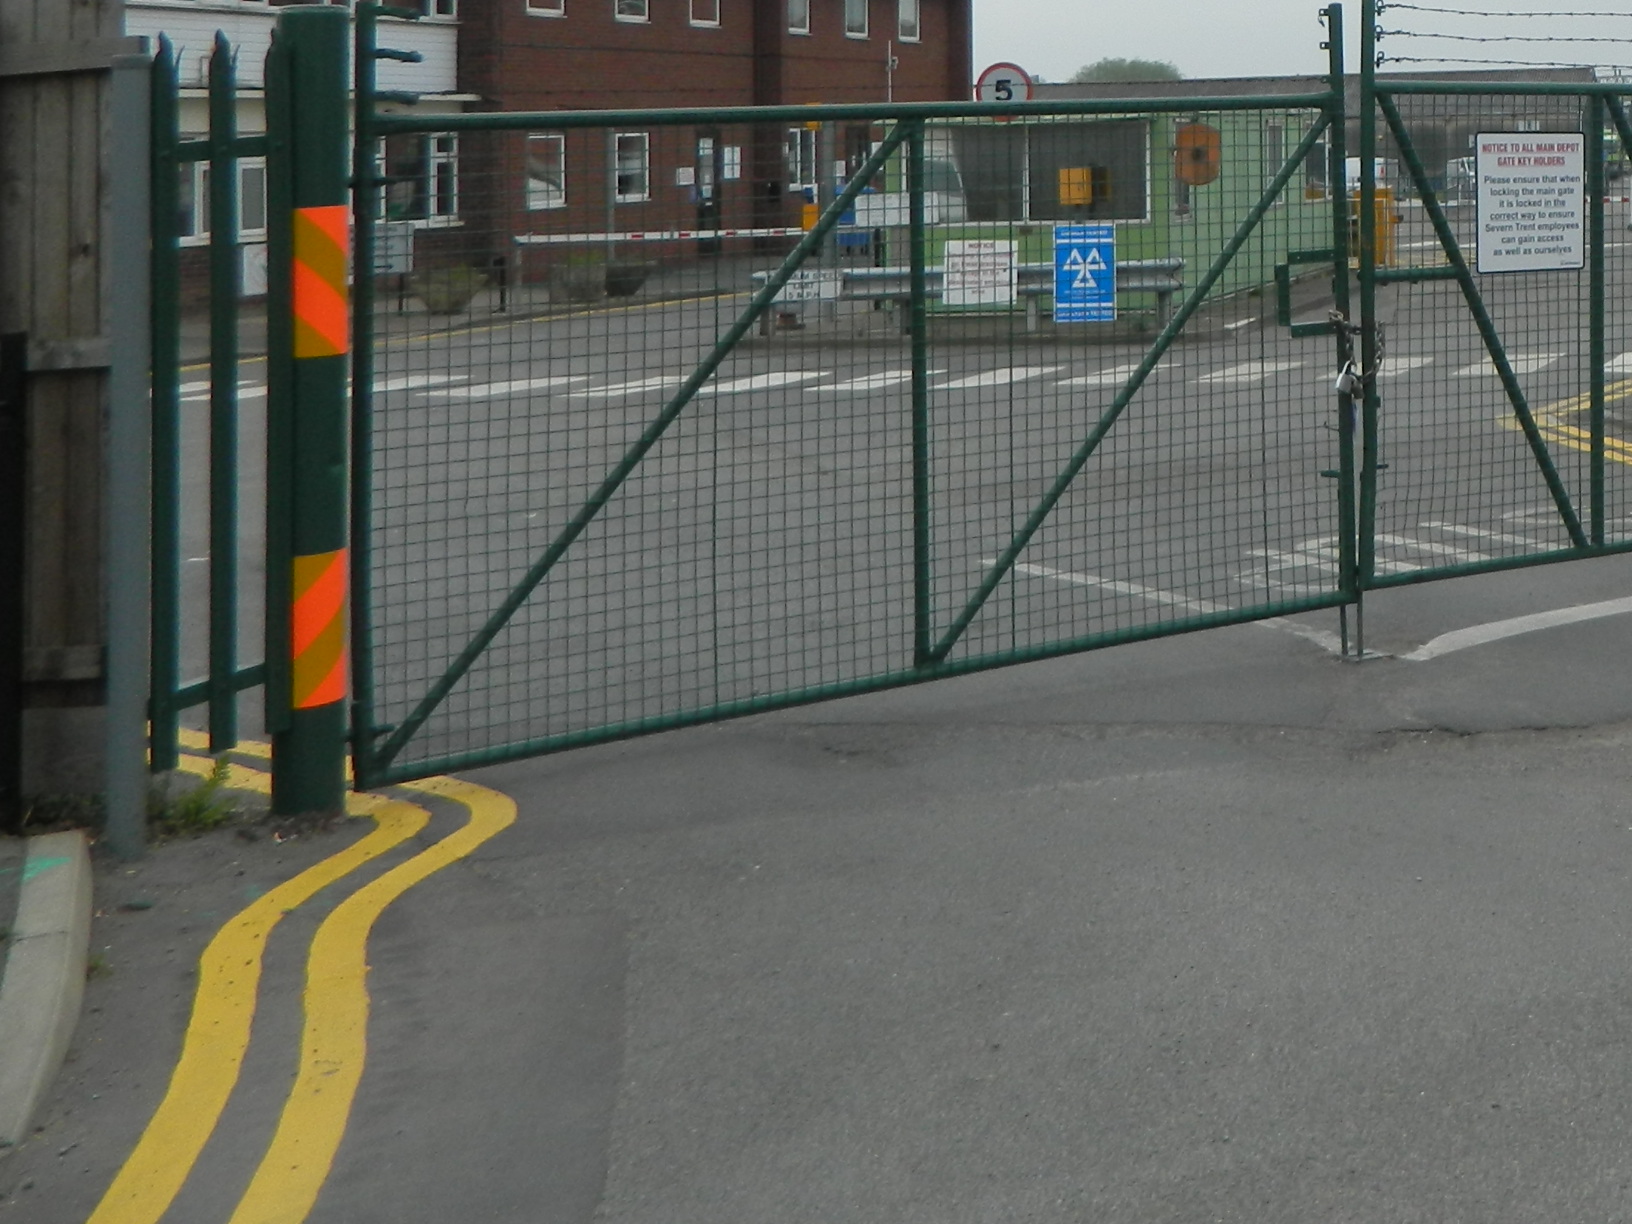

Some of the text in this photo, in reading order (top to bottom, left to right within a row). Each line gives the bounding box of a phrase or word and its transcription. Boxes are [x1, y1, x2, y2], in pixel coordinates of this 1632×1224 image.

[995, 79, 1013, 101] 5
[1482, 142, 1580, 153] NOTICE TO ALL MAIN DEPOT
[1497, 156, 1566, 166] GATE KEY HOLDERS
[1484, 176, 1511, 184] Please
[1559, 175, 1581, 183] when
[1490, 187, 1520, 197] locking
[1536, 187, 1556, 195] main
[1557, 187, 1575, 196] gate
[1506, 199, 1514, 207] is
[1516, 199, 1542, 207] locked
[1544, 199, 1552, 207] in
[1553, 198, 1566, 206] the
[1489, 212, 1519, 221] correct
[1485, 222, 1580, 232] Severn Trent employees
[1501, 234, 1564, 245] can gain access
[1505, 247, 1521, 255] well
[1534, 245, 1572, 255] ourselves
